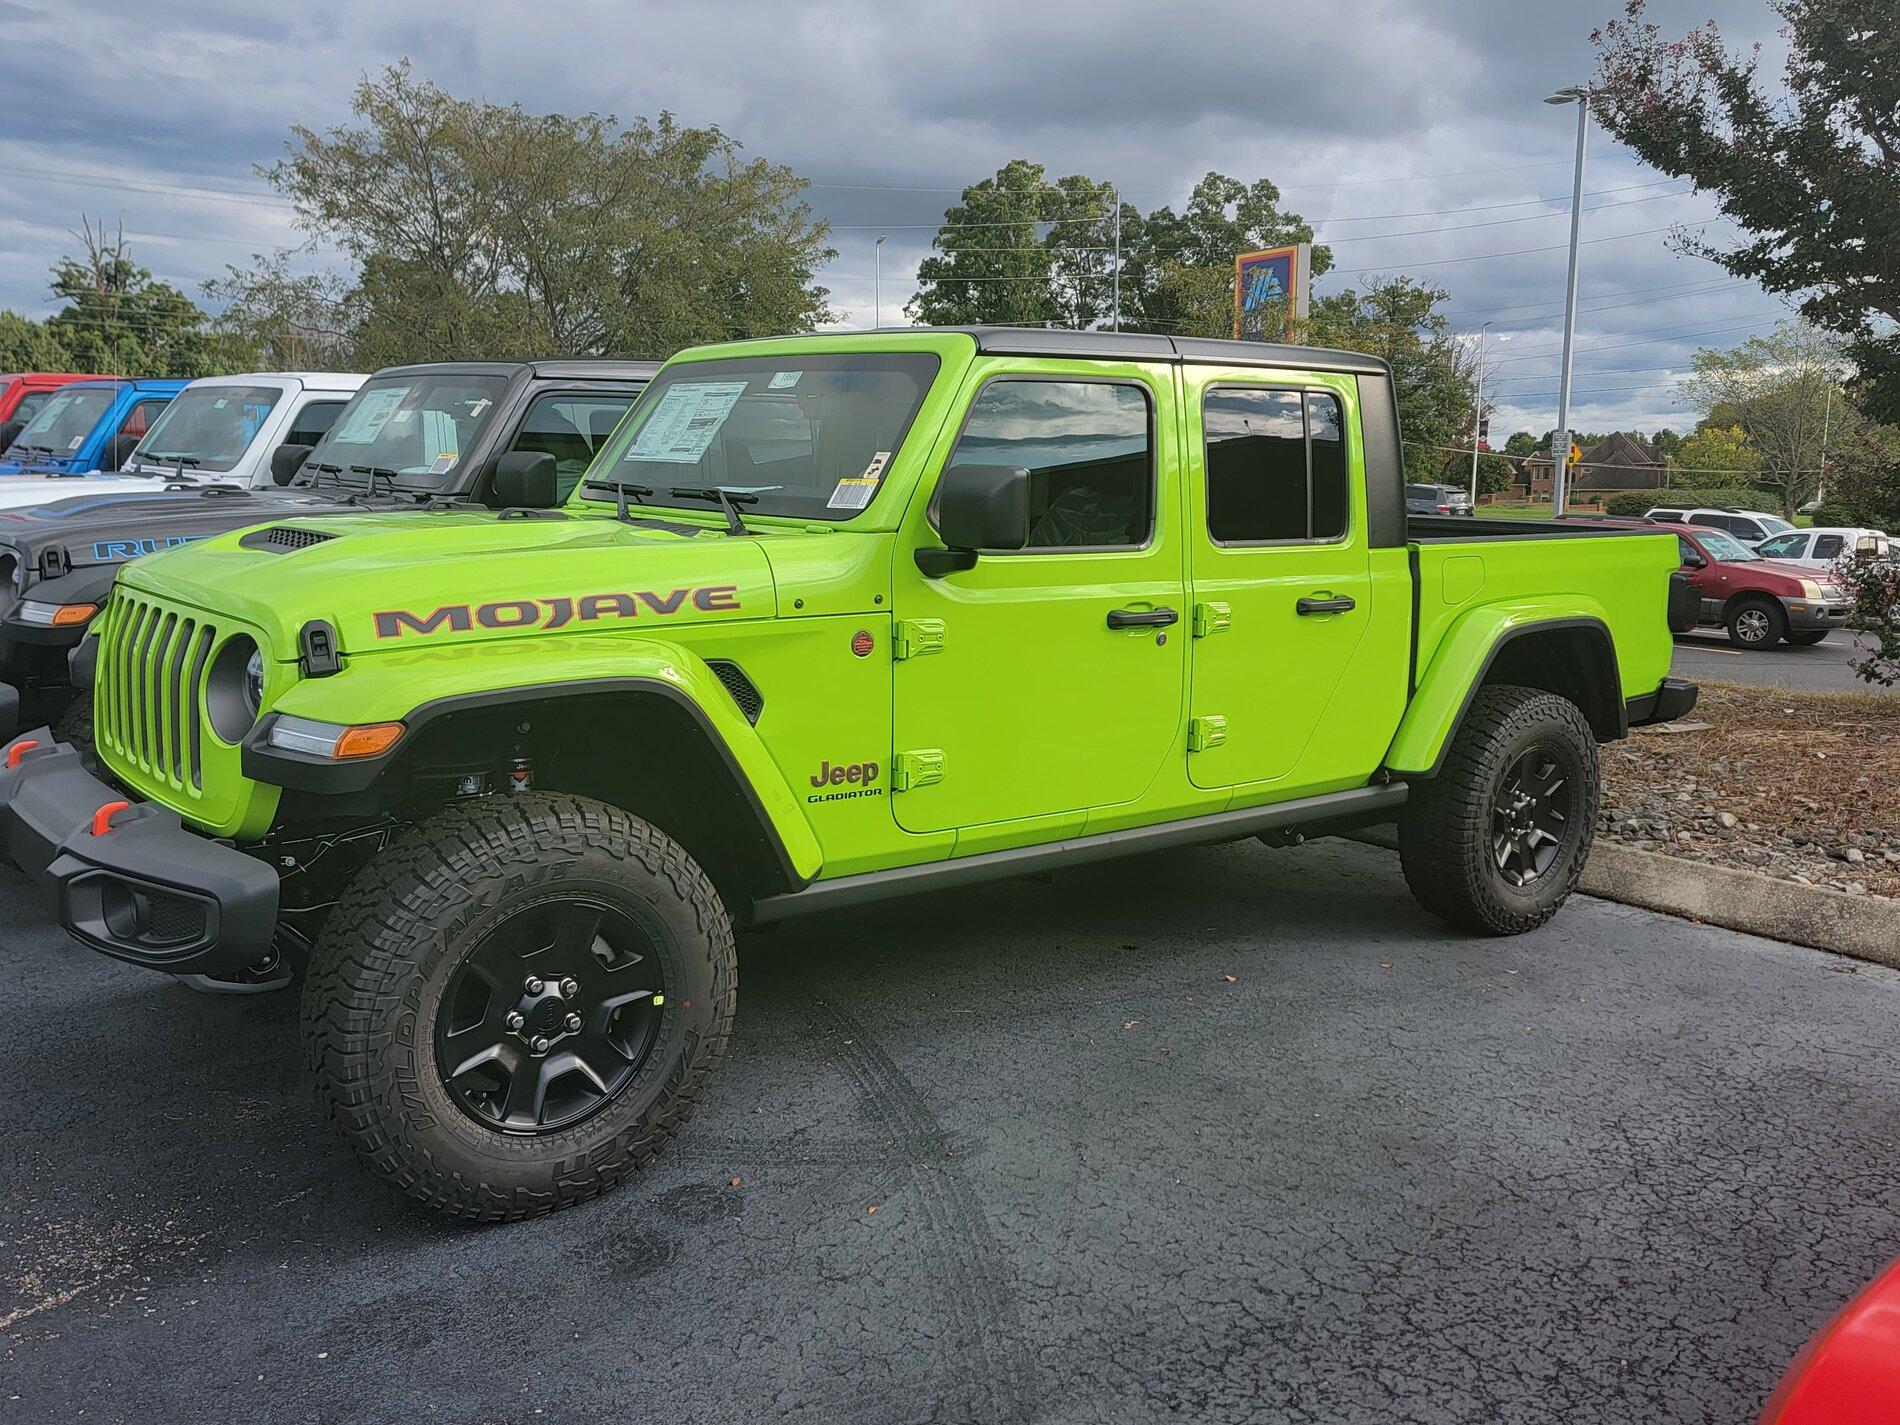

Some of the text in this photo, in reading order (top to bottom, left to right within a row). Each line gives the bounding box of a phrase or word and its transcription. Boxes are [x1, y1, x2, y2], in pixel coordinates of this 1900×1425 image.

[93, 535, 214, 560] RU
[373, 584, 742, 639] MOJAVE
[810, 761, 879, 788] Jeep
[807, 788, 883, 803] GLADIATOR
[396, 888, 494, 1132] WILDPEAK
